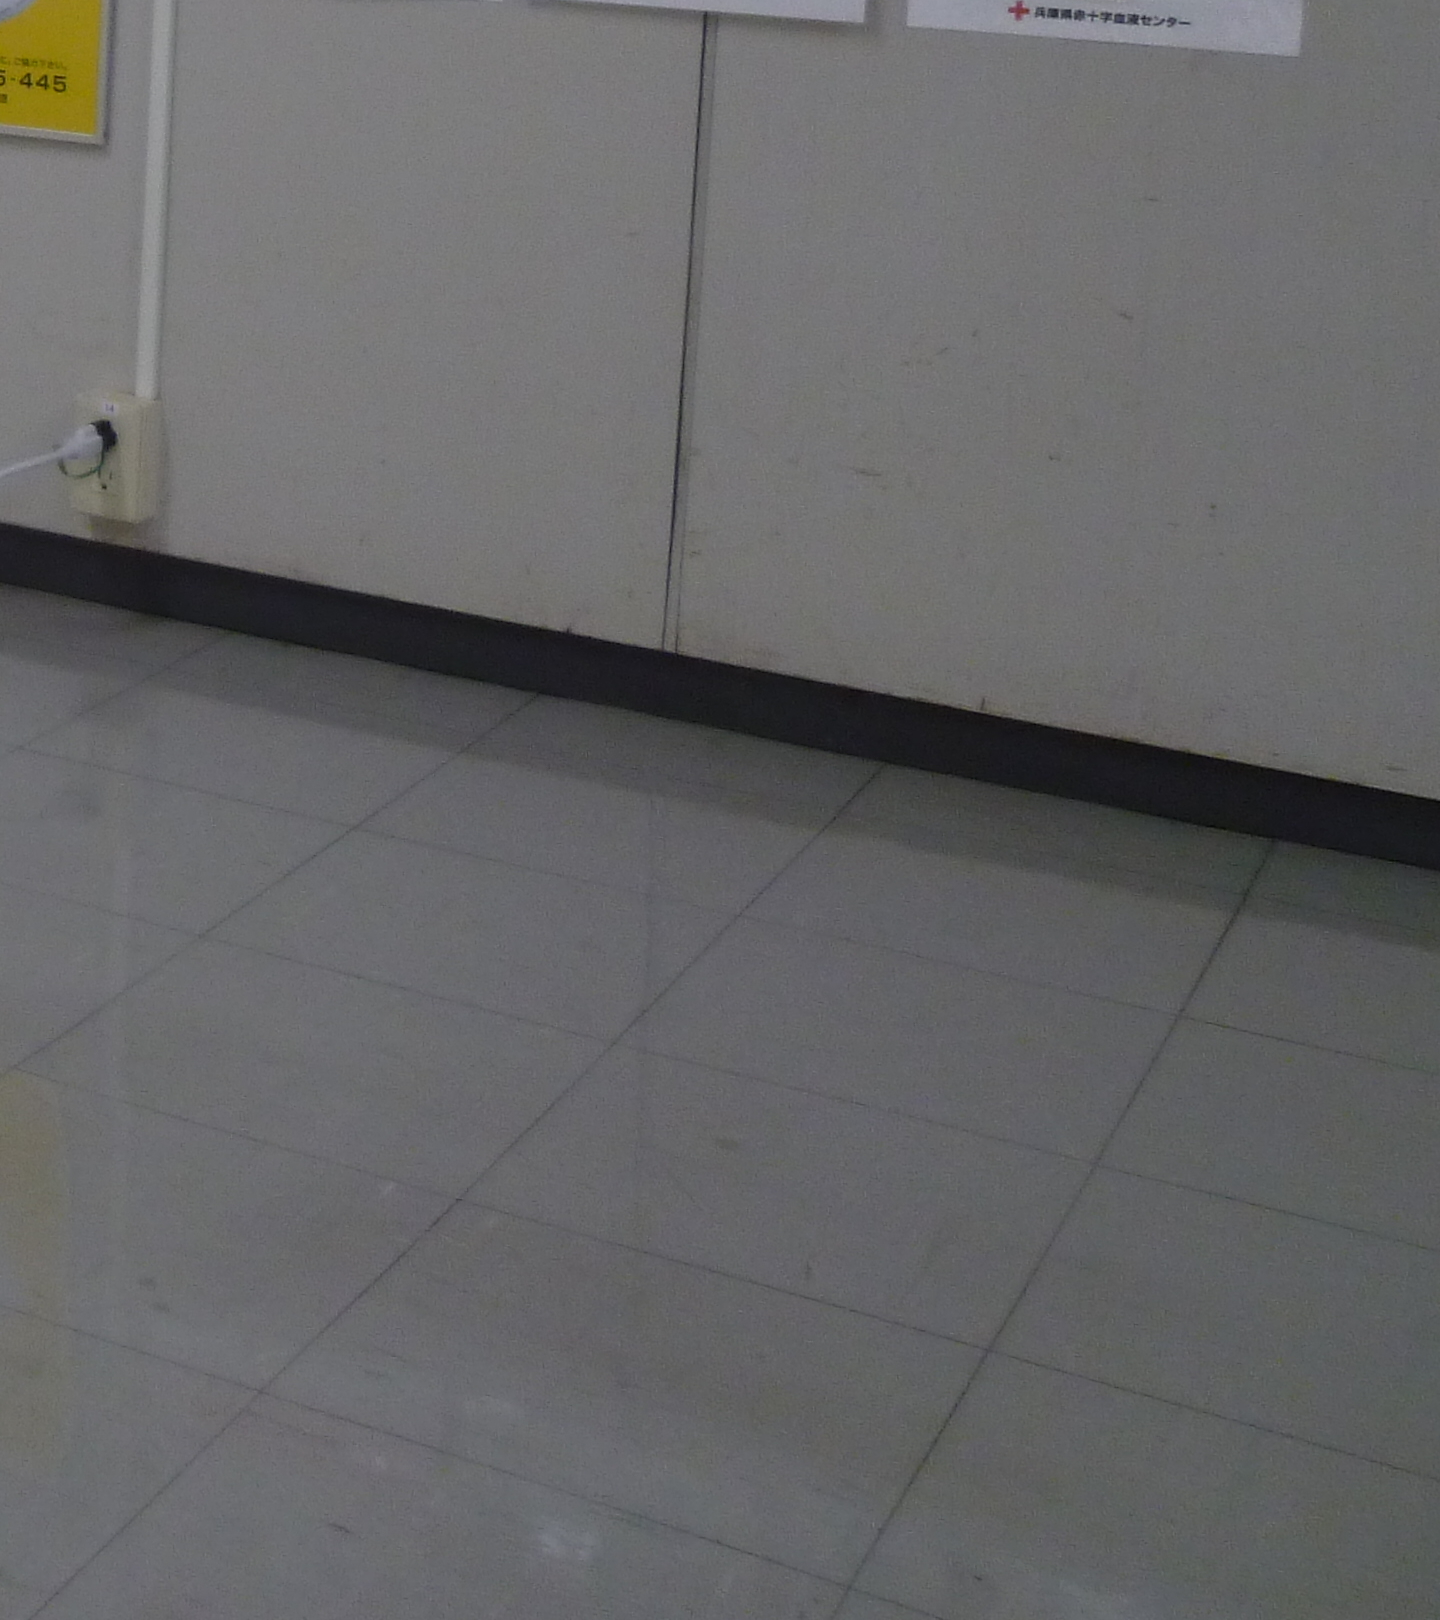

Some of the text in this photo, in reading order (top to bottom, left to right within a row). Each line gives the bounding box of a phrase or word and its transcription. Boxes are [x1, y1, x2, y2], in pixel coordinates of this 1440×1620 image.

[1033, 6, 1191, 29] 兵庫県赤十字血液センター
